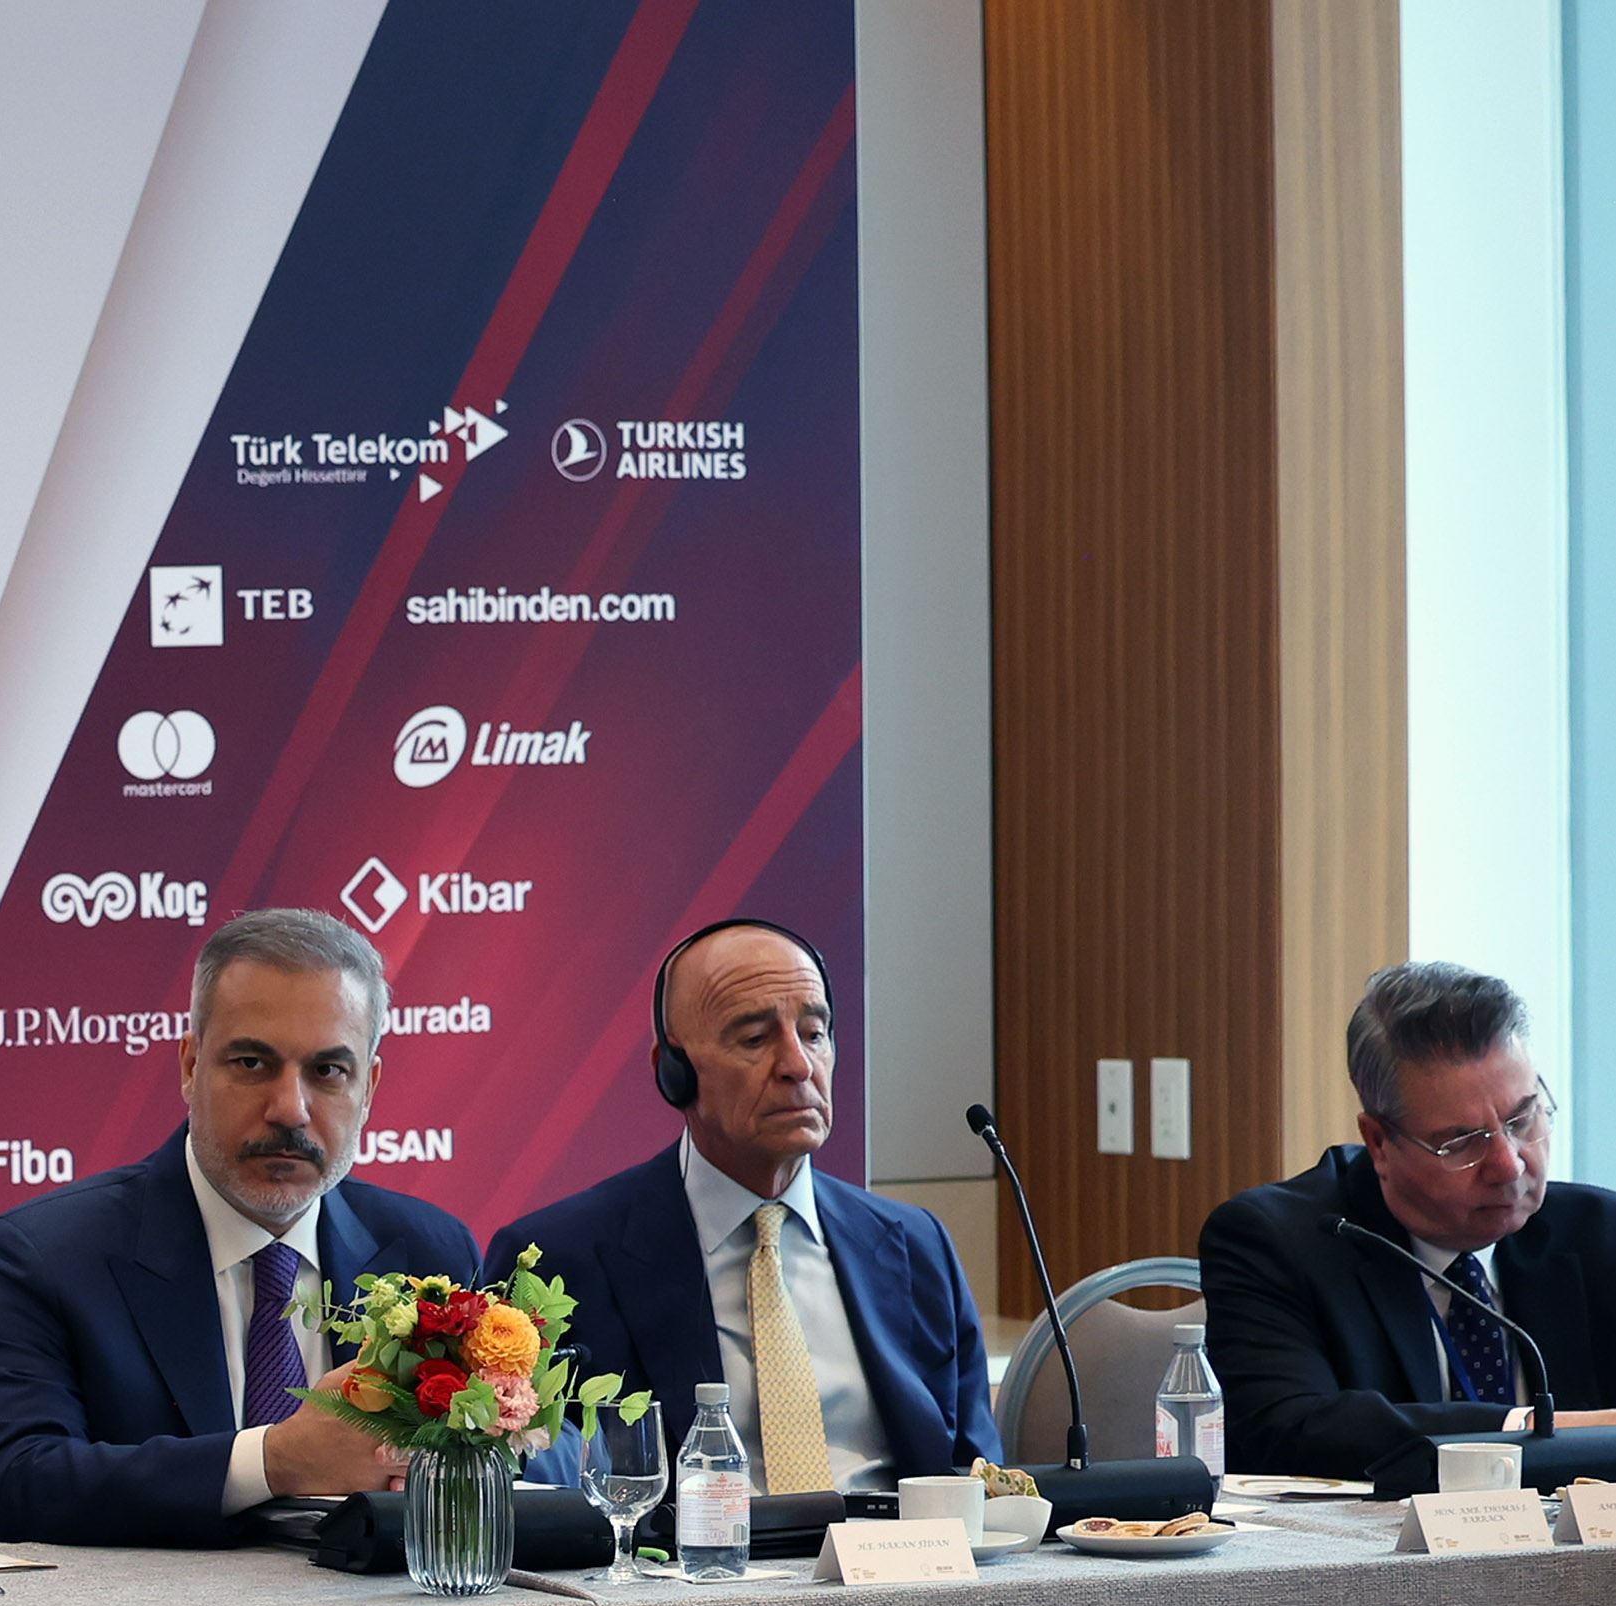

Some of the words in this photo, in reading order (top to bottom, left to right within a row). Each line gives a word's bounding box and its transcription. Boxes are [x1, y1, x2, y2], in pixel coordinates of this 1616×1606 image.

[230, 434, 303, 466] Türk
[311, 433, 449, 465] Telekom
[617, 421, 745, 450] TURKISH
[616, 451, 747, 481] AIRLINES
[237, 588, 314, 622] TEB
[406, 586, 676, 625] sahibinden.com
[470, 720, 592, 766] Limak
[123, 780, 213, 798] mastercard
[139, 871, 208, 926] Koç
[418, 872, 533, 914] Kibar
[354, 1128, 453, 1164] USAN
